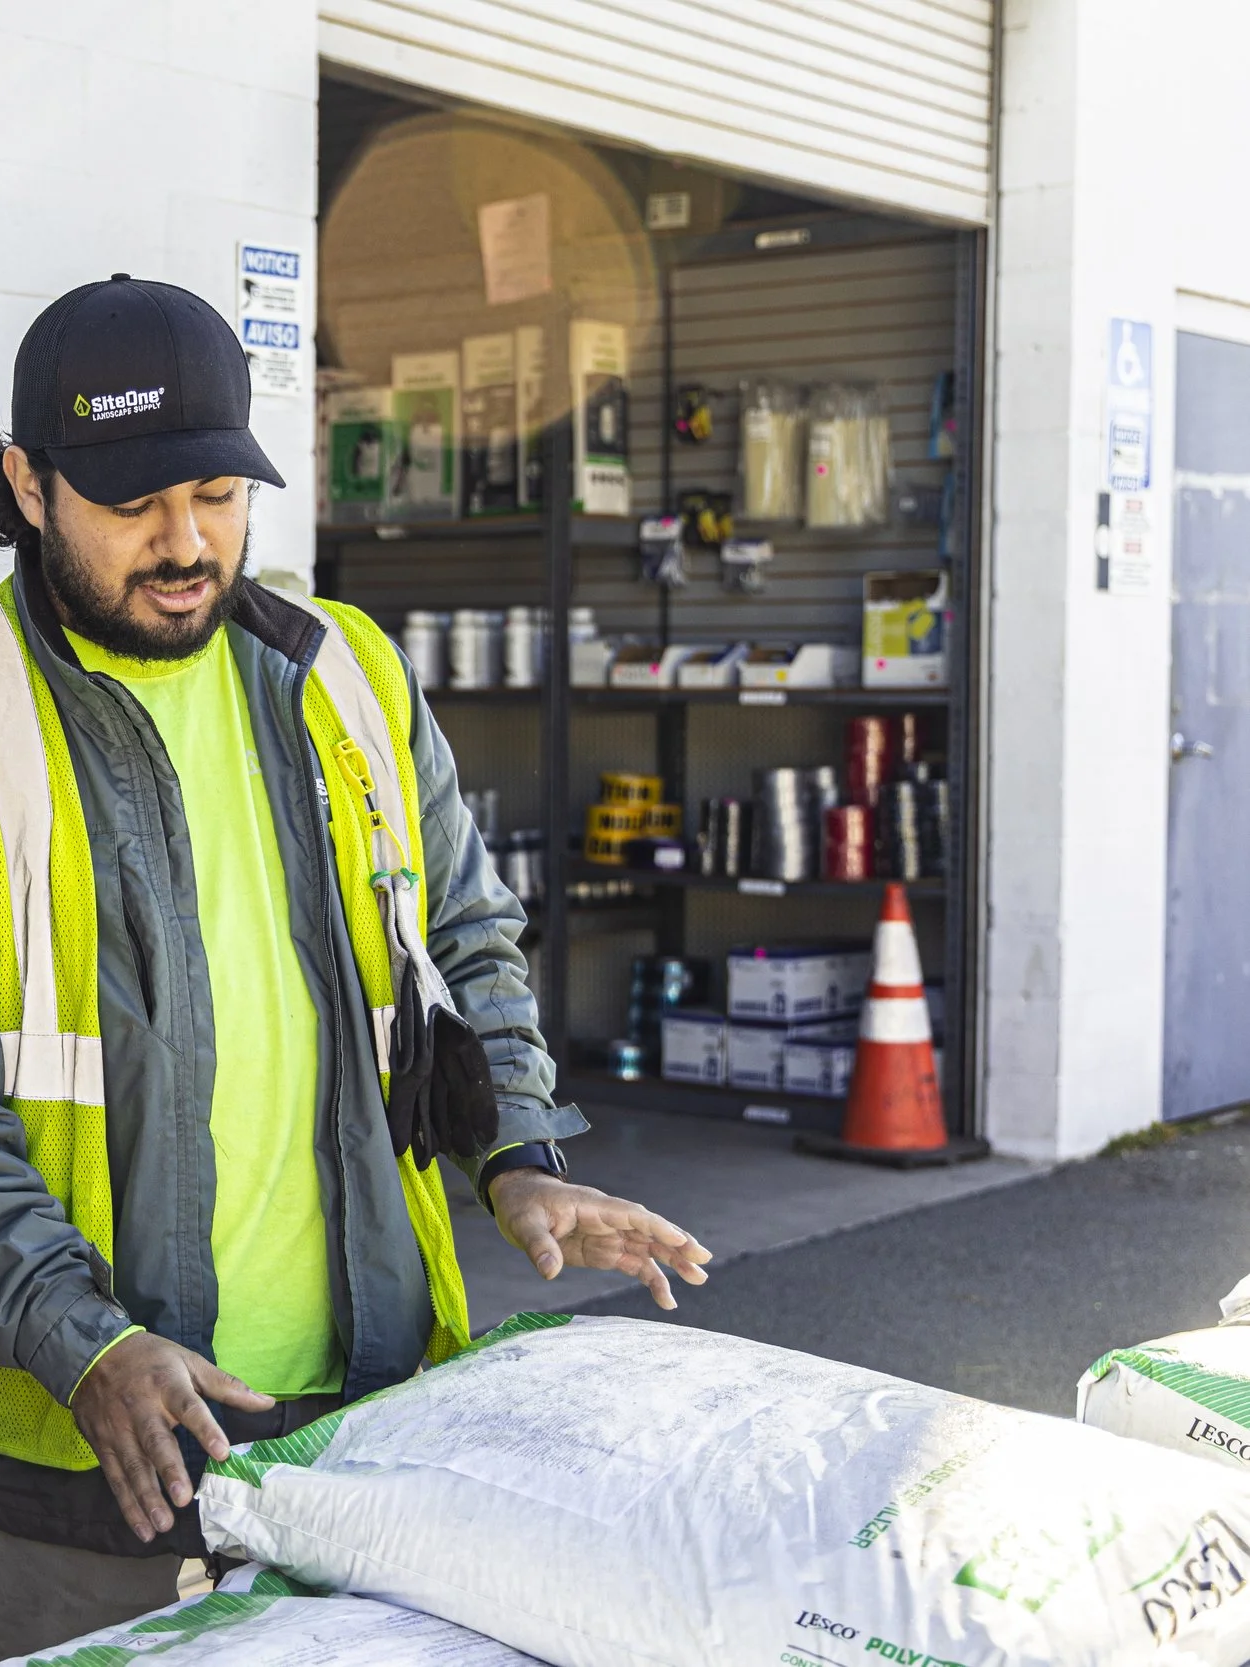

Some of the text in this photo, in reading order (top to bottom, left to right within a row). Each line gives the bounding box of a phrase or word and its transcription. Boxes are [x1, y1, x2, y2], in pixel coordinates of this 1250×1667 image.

[244, 249, 298, 277] NOTICE
[247, 321, 297, 348] AVISO
[92, 402, 161, 421] LANDSCAPE SUPPLY
[1185, 1416, 1250, 1461] LESCO
[795, 1609, 858, 1641] LESCO
